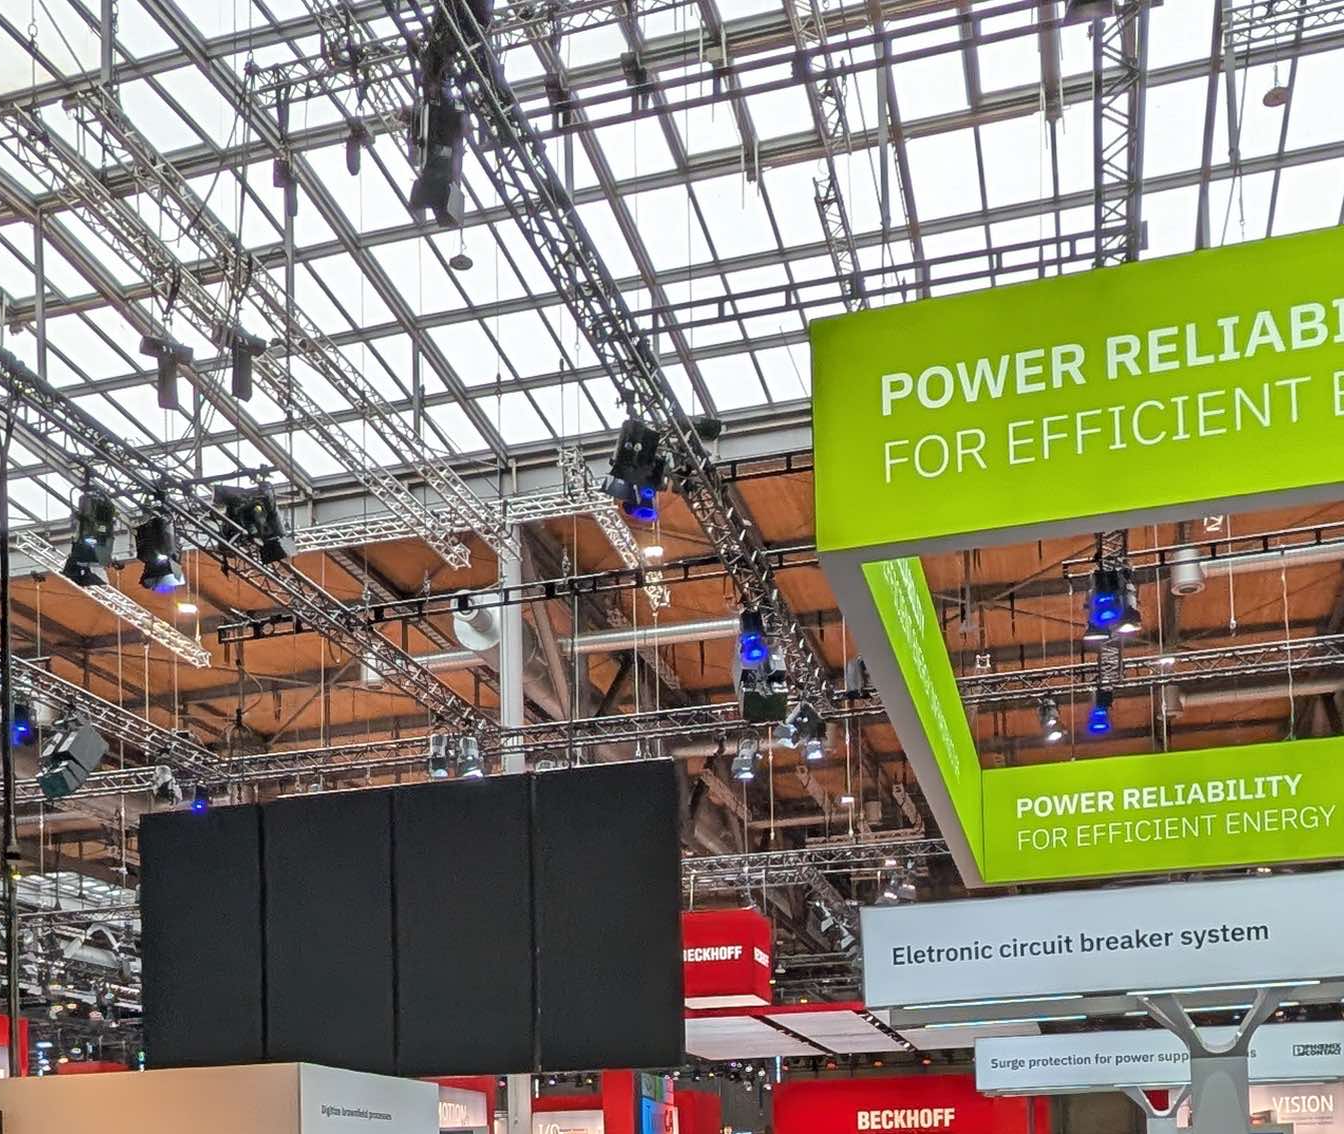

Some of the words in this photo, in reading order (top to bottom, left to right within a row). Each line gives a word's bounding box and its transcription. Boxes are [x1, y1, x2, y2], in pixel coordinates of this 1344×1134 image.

[881, 341, 1087, 416] POWER
[884, 428, 989, 484] FOR
[1008, 376, 1312, 465] EFFICIENT
[1016, 791, 1115, 820] POWER
[1122, 773, 1303, 811] RELIABILITY
[1017, 828, 1068, 852] FOR
[1075, 813, 1217, 848] EFFICIENT
[1225, 803, 1338, 836] ENERGY
[892, 940, 994, 967] Eletronic
[998, 934, 1074, 959] circuit
[1079, 927, 1175, 954] breaker
[1180, 921, 1270, 950] system
[990, 1056, 1026, 1071] Surge
[1028, 1052, 1092, 1070] protection
[1094, 1052, 1113, 1066] for
[1115, 1053, 1155, 1069] power
[857, 1107, 956, 1131] BECKHOFF
[1272, 1094, 1334, 1113] VISION
